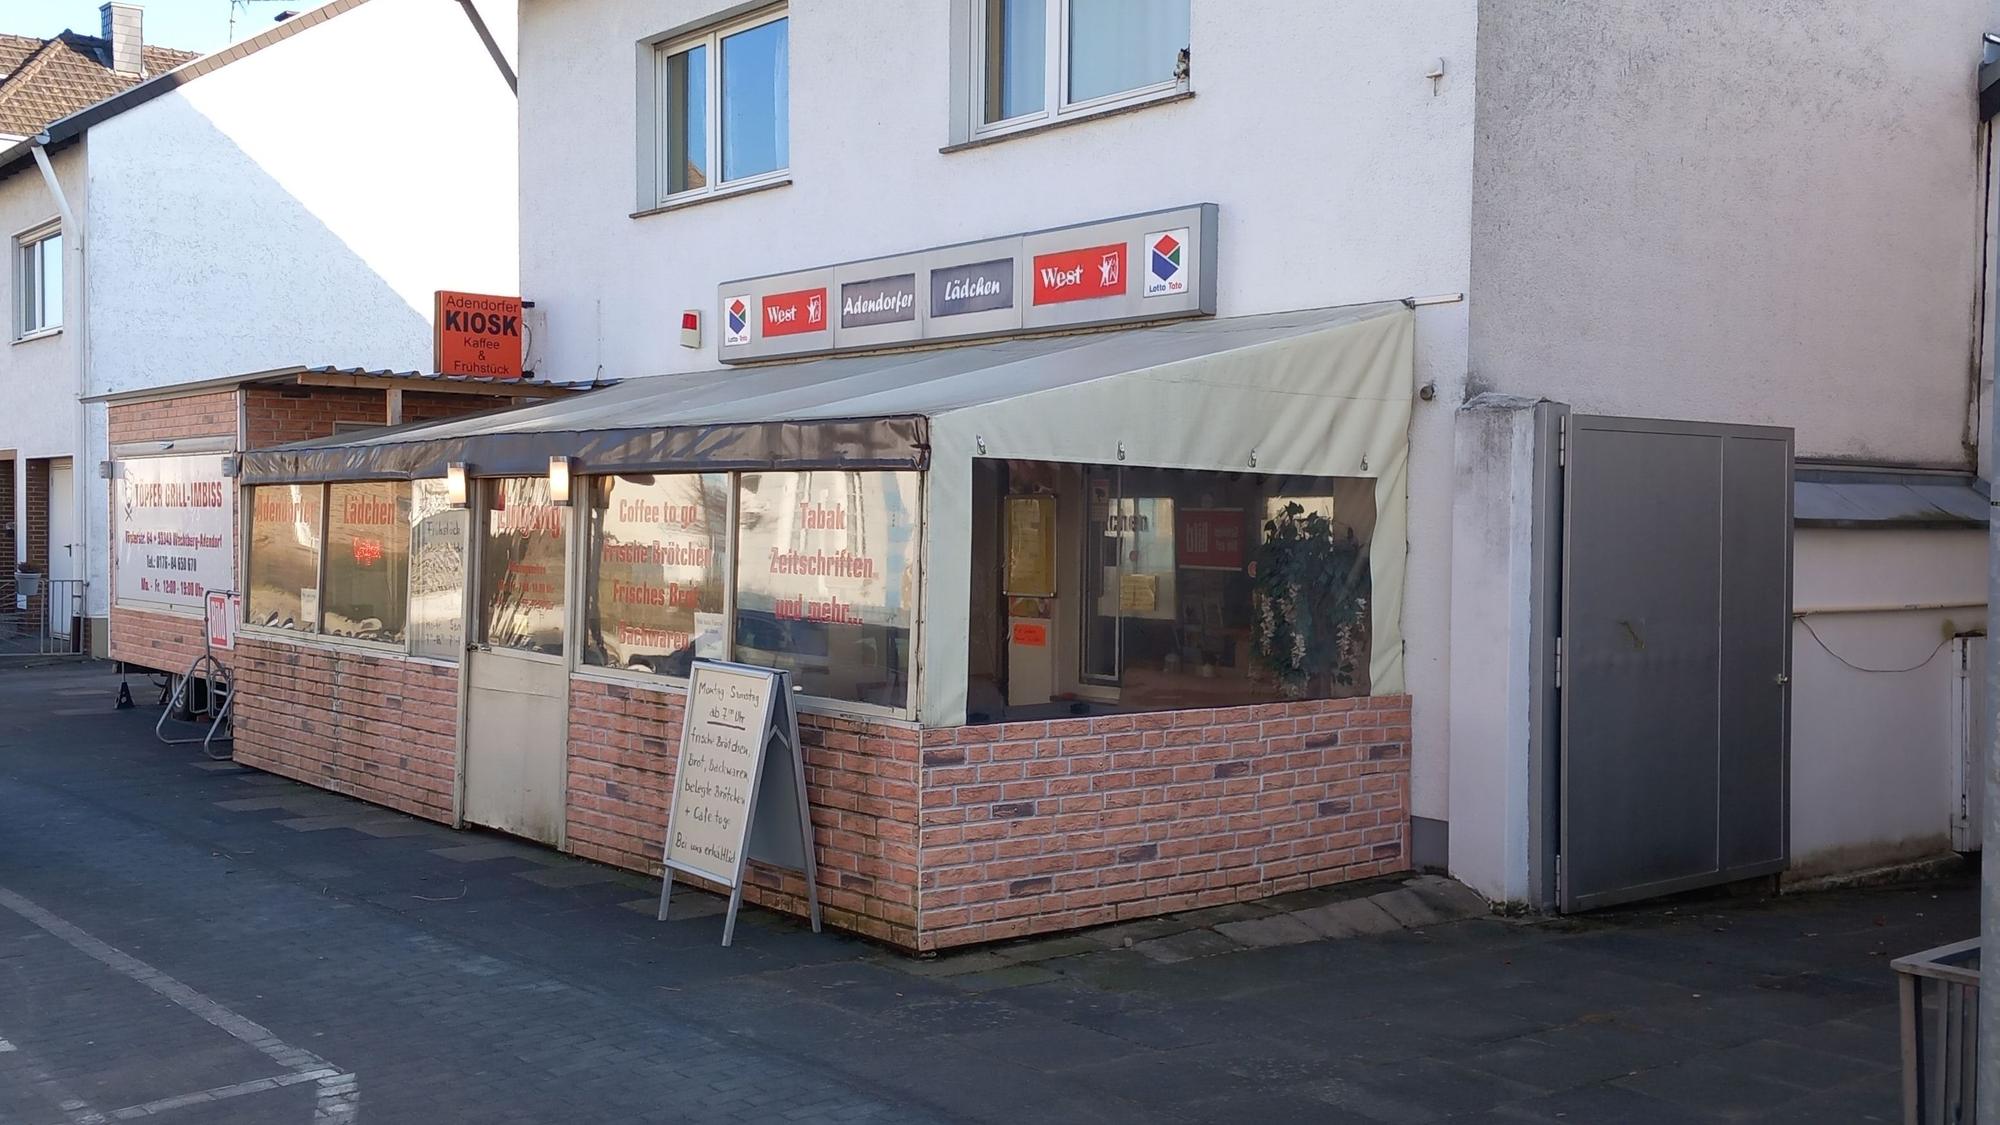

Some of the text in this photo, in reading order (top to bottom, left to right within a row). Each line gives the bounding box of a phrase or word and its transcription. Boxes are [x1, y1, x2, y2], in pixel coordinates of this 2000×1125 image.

[1041, 266, 1084, 291] West
[1149, 282, 1183, 293] Lotto Toto
[446, 295, 518, 312] Adendorfer
[843, 275, 1000, 316] Adendorfer Lädchen
[445, 309, 518, 337] KIOSK
[767, 306, 797, 326] West
[463, 337, 500, 349] Kaffee
[478, 350, 485, 361] &
[343, 494, 395, 525] Lädchen
[619, 499, 697, 529] Coffee to go
[800, 502, 845, 530] Tabak
[603, 538, 712, 567] Frische Brötchen
[612, 579, 665, 606] Frisches
[775, 593, 803, 620] und
[617, 619, 689, 650] Backwaren
[709, 705, 719, 718] ab
[675, 831, 687, 849] Bei
